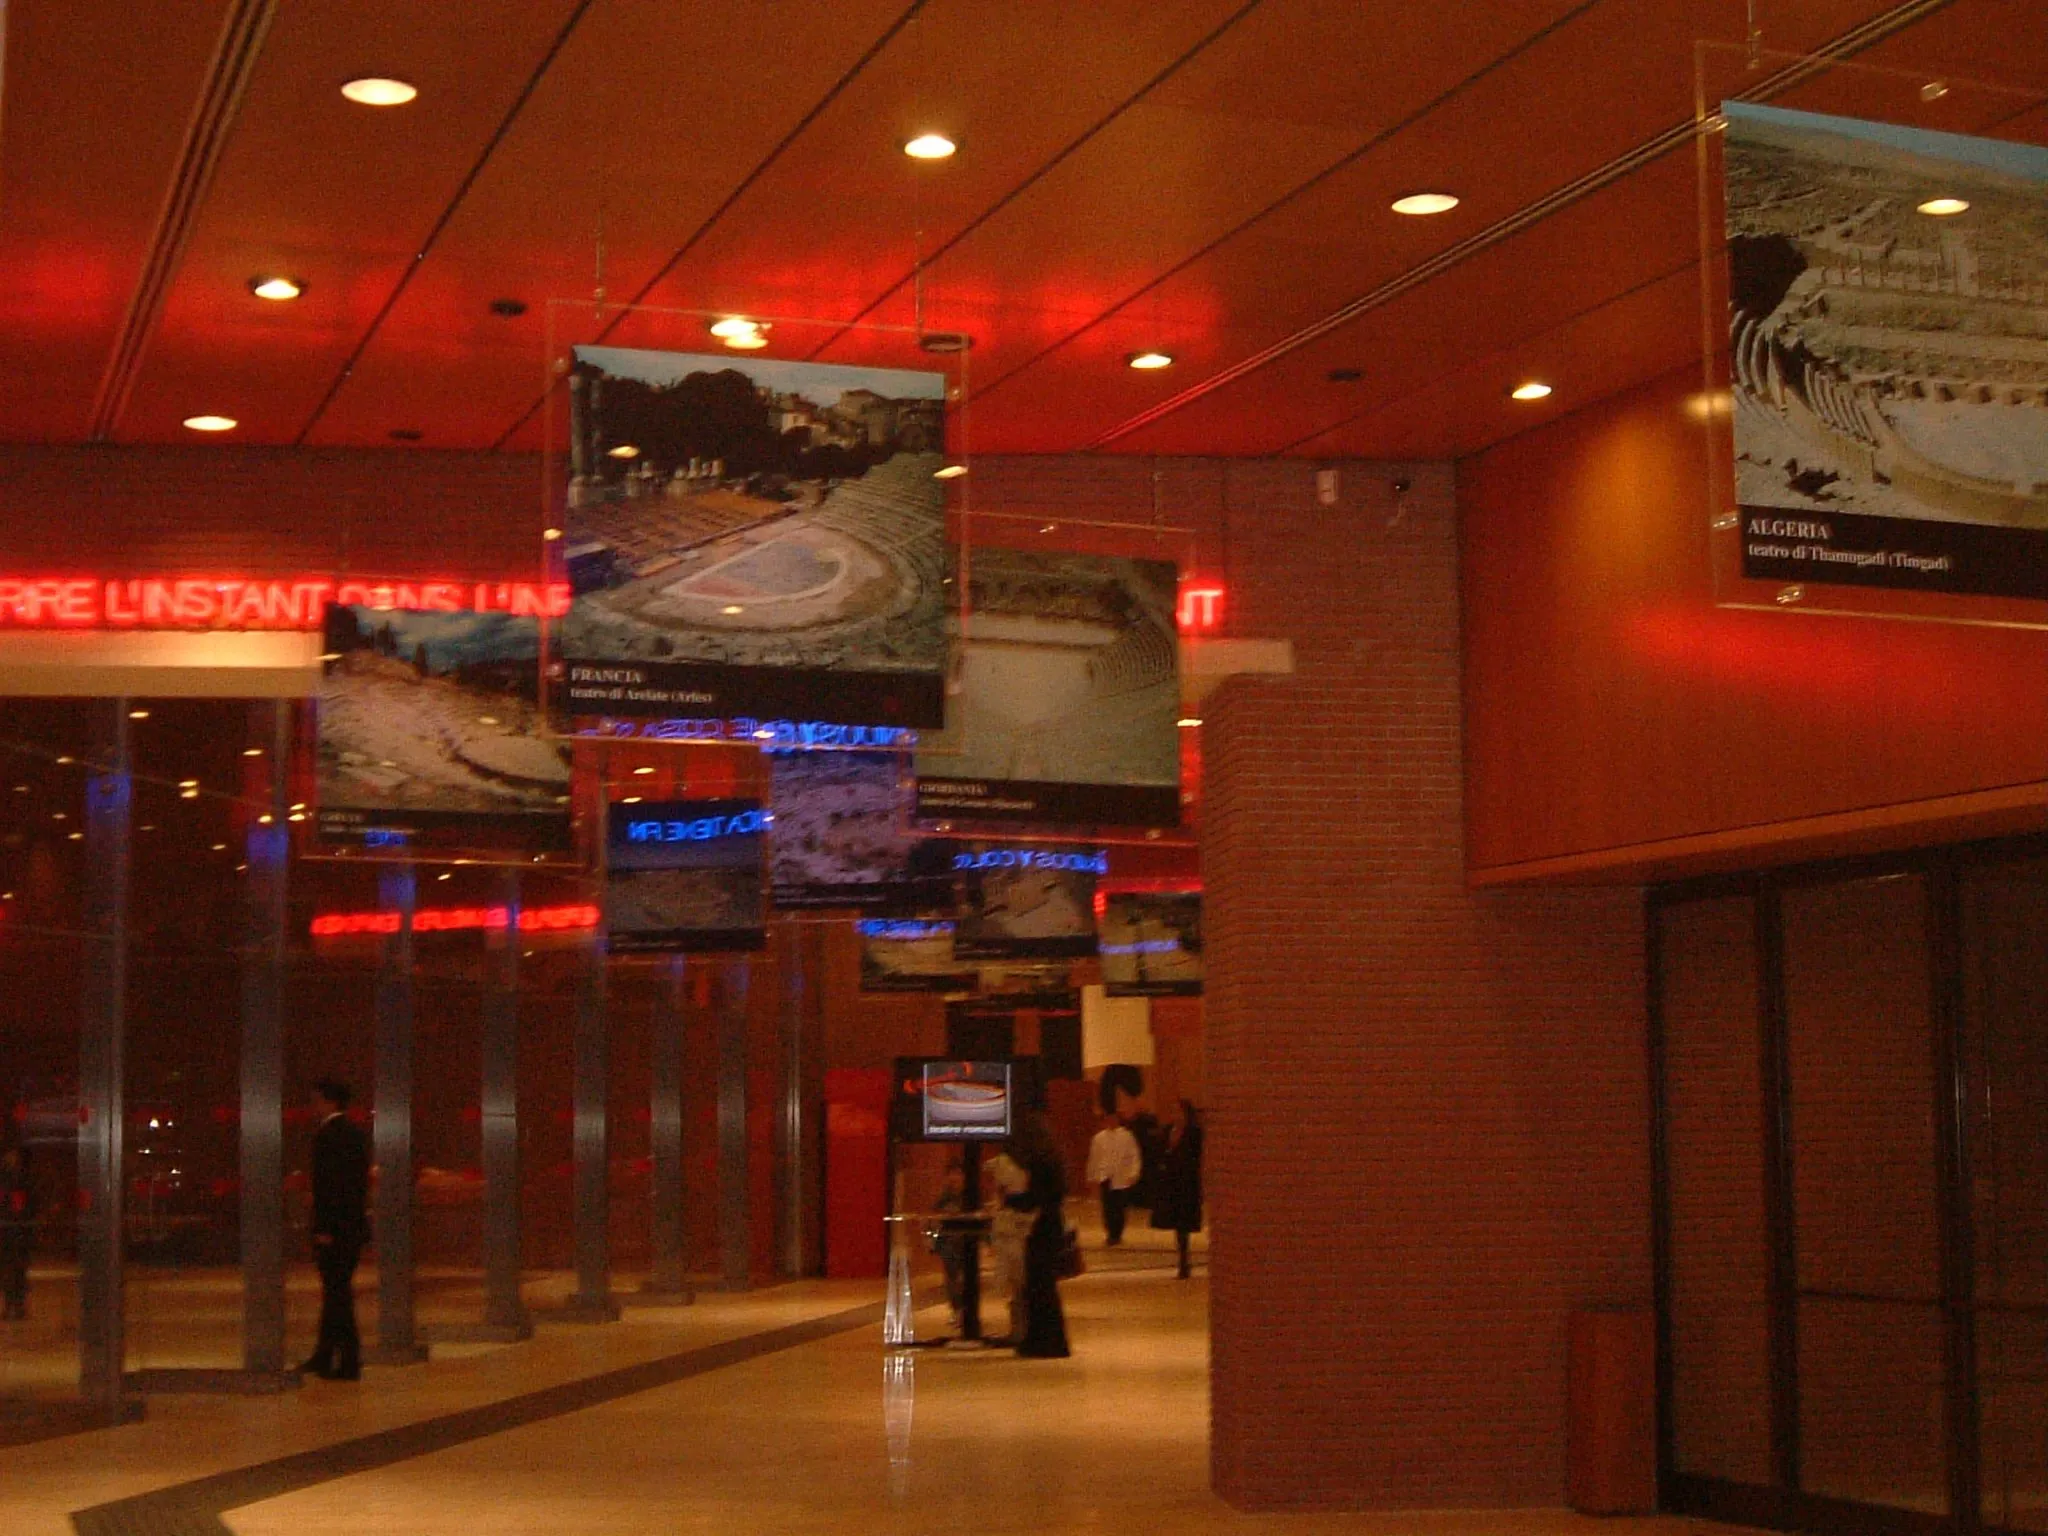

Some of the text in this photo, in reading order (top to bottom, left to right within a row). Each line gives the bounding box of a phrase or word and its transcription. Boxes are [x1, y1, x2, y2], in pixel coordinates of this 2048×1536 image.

[1748, 518, 1829, 540] ALGERIA
[1748, 543, 1789, 557] teatro
[1792, 544, 1806, 559] di
[104, 580, 333, 622] L'INSTANT
[570, 667, 642, 683] FRANCIA
[570, 687, 606, 699] teatro
[608, 688, 622, 700] di
